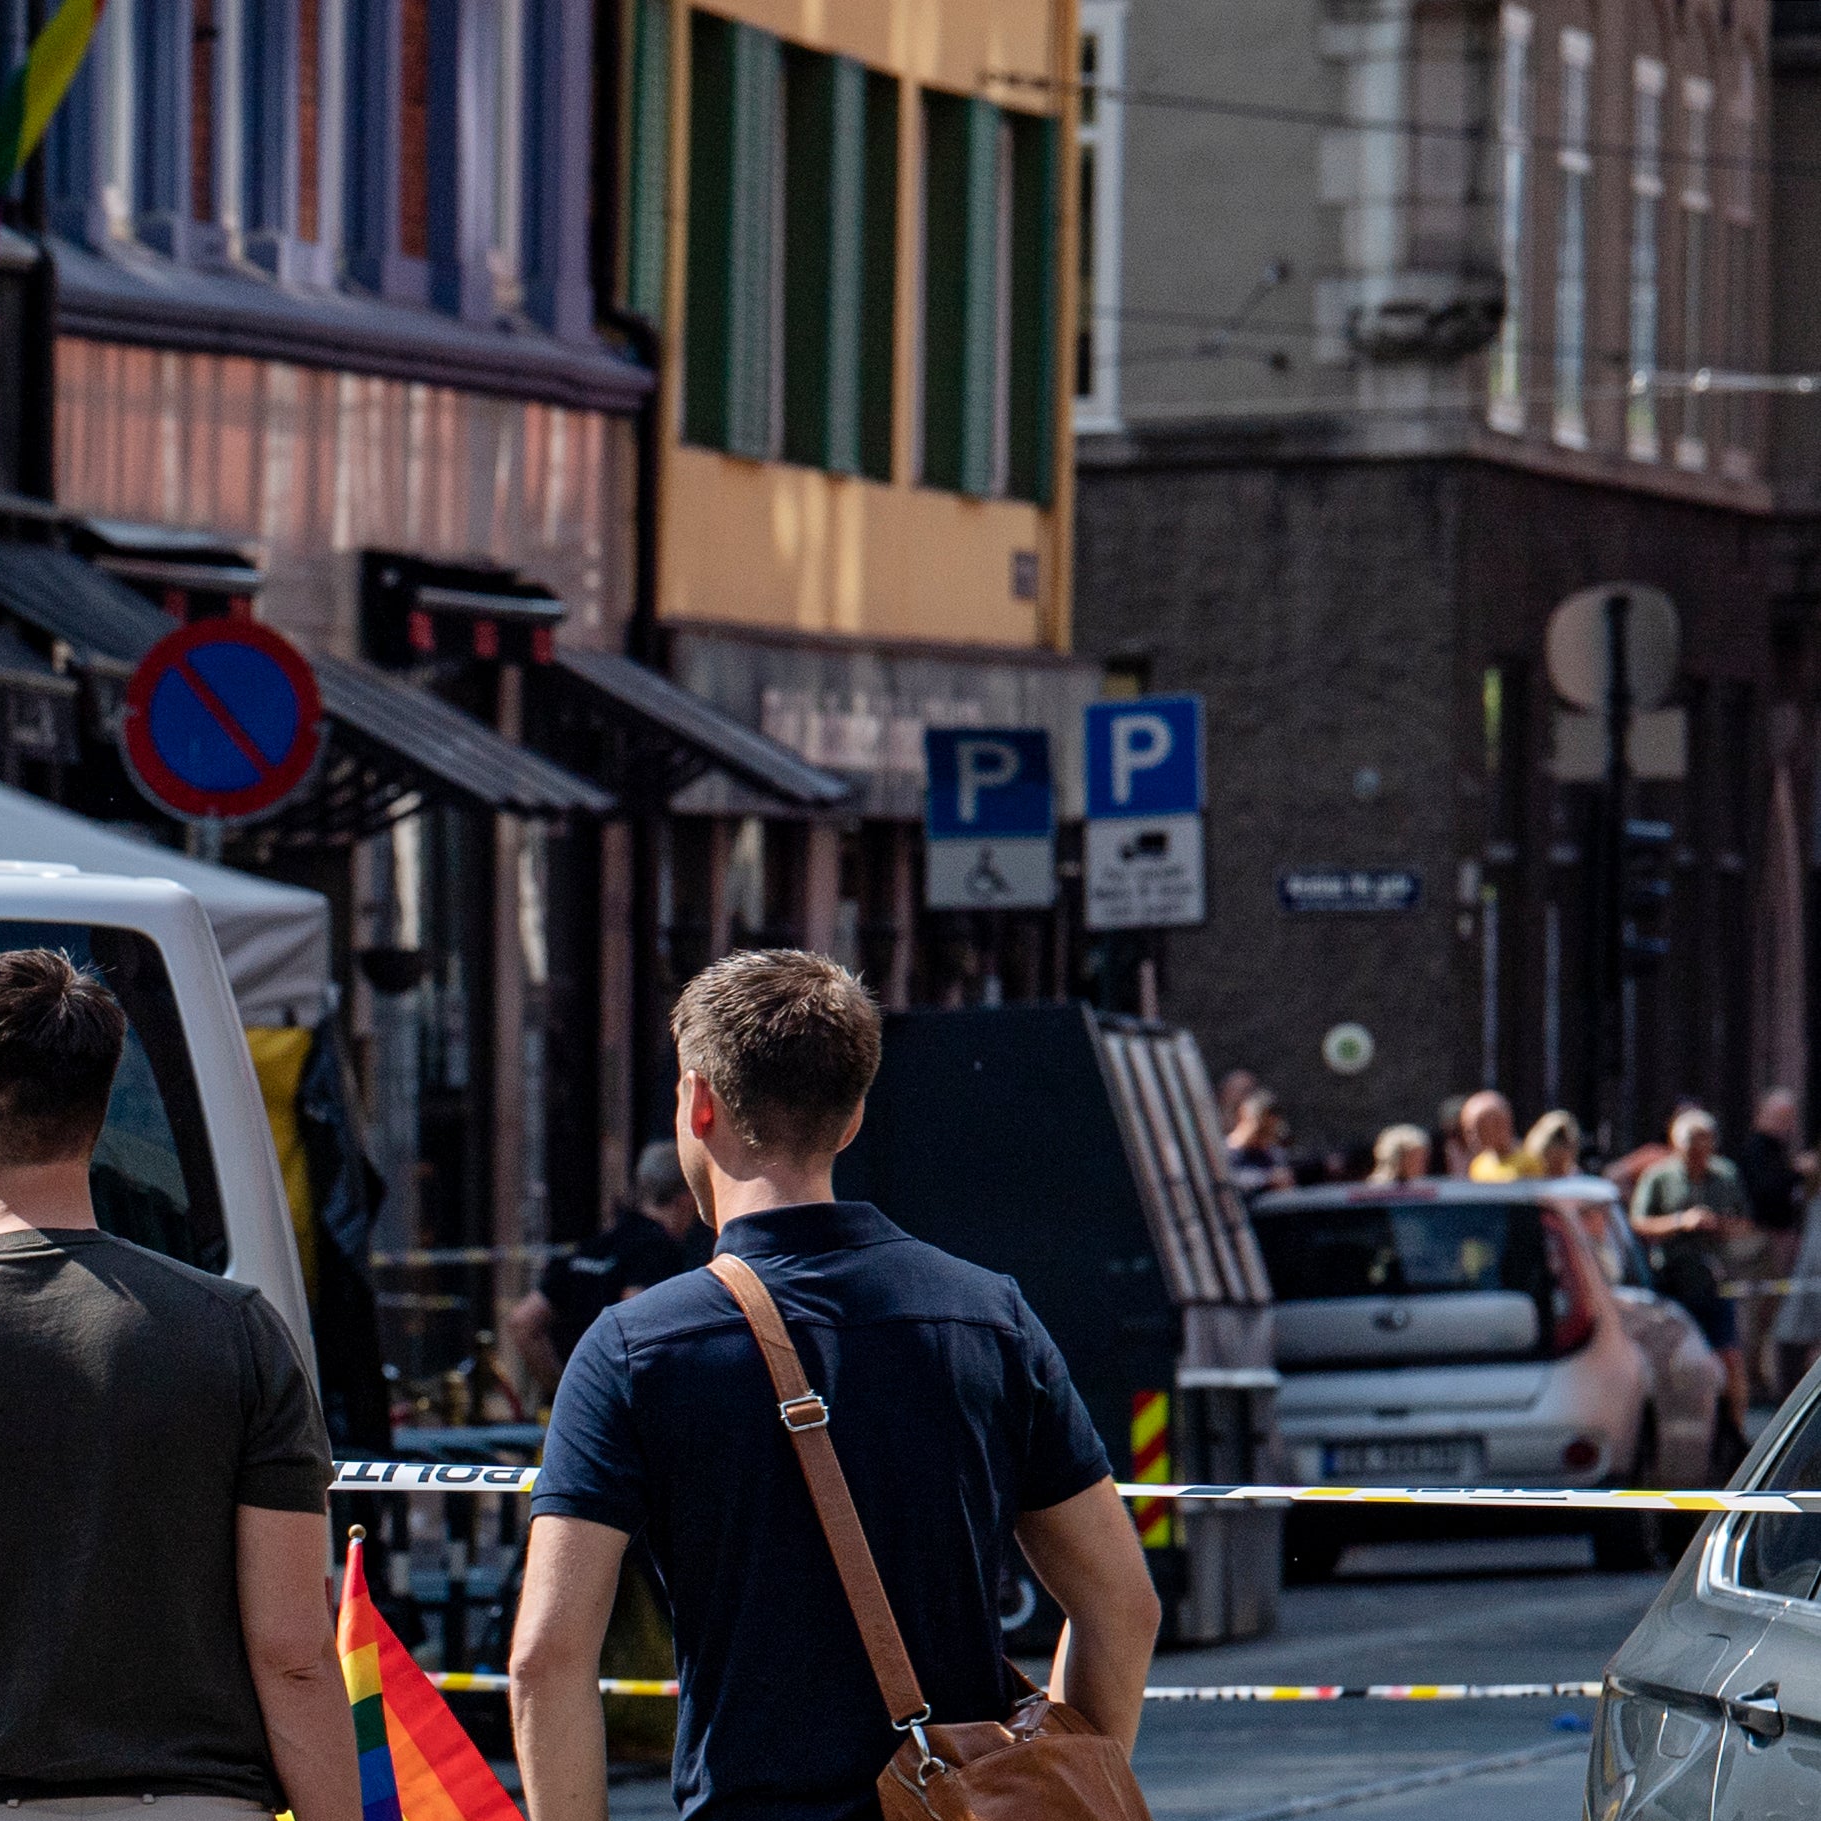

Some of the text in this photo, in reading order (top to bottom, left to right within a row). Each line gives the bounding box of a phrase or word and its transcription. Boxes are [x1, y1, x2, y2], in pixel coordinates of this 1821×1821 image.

[956, 739, 1020, 823] P
[1110, 712, 1173, 805] P
[334, 1462, 525, 1485] POLITI
